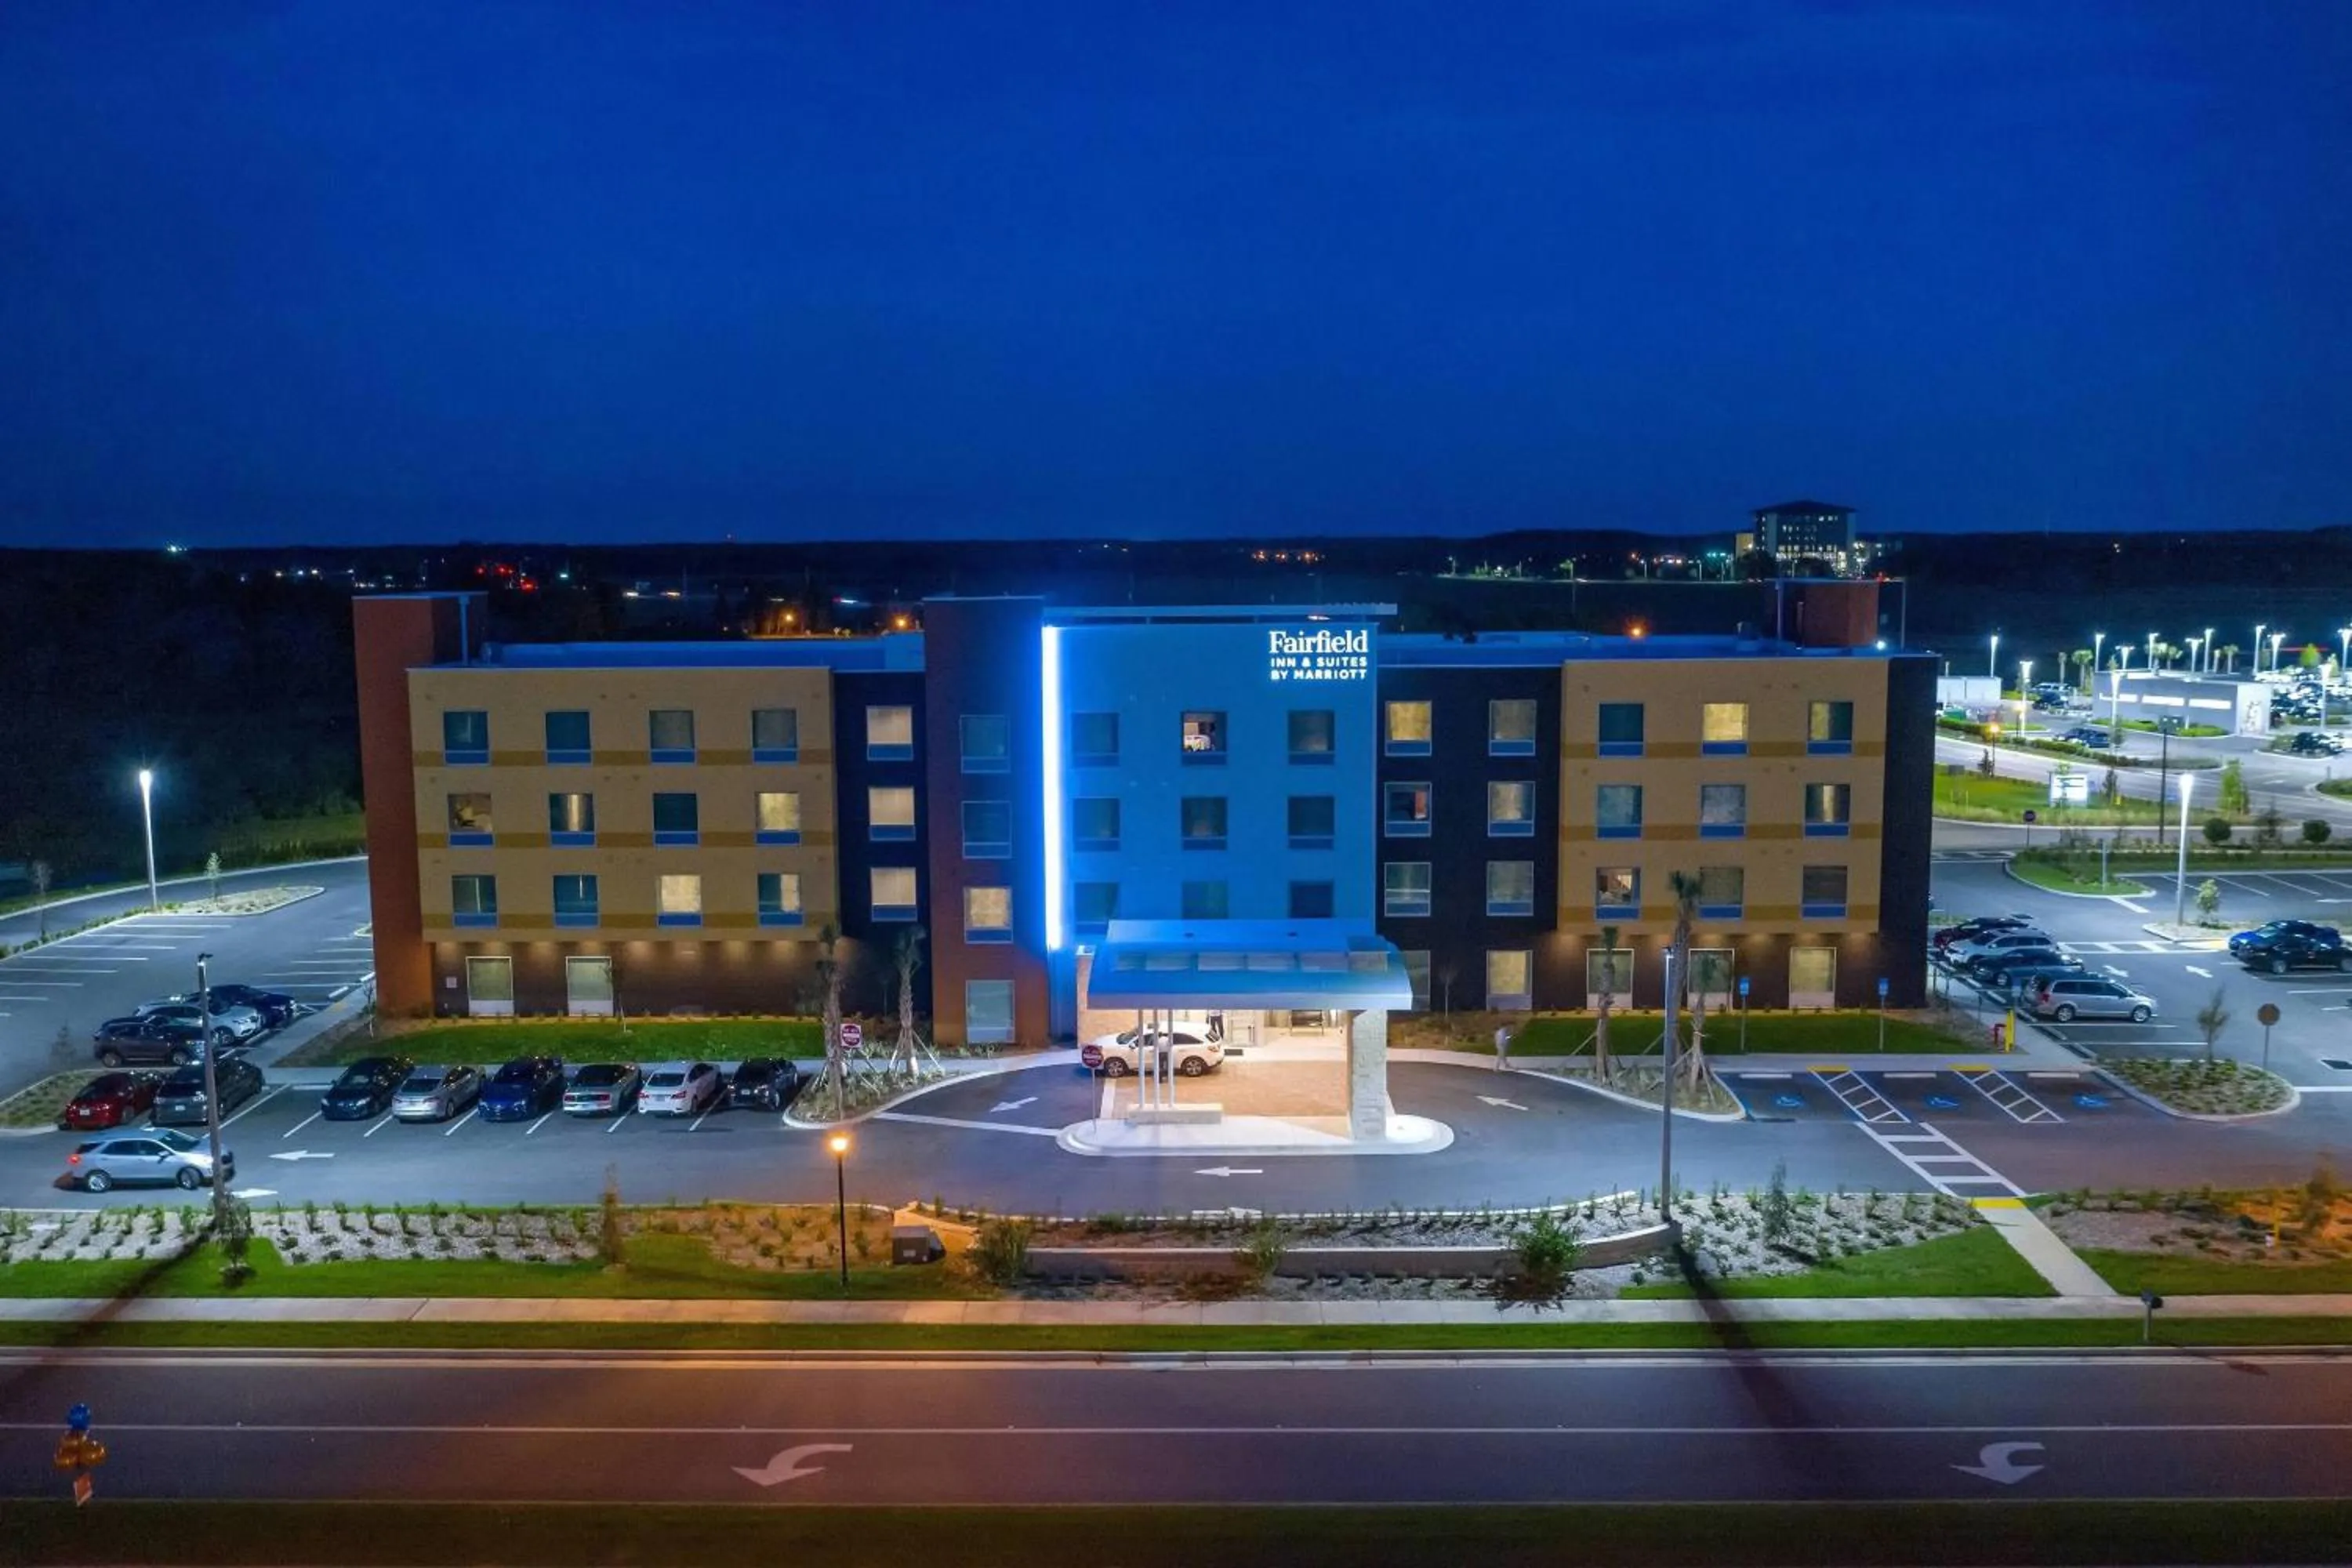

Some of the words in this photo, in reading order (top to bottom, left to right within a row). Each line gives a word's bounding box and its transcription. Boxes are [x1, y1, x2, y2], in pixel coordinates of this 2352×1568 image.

[1269, 630, 1368, 653] Fairfield
[1271, 657, 1296, 667] INN
[1301, 657, 1311, 667] &
[1316, 657, 1367, 667] SUITES
[1270, 669, 1287, 680] BY
[1294, 669, 1367, 680] MARRIOTT
